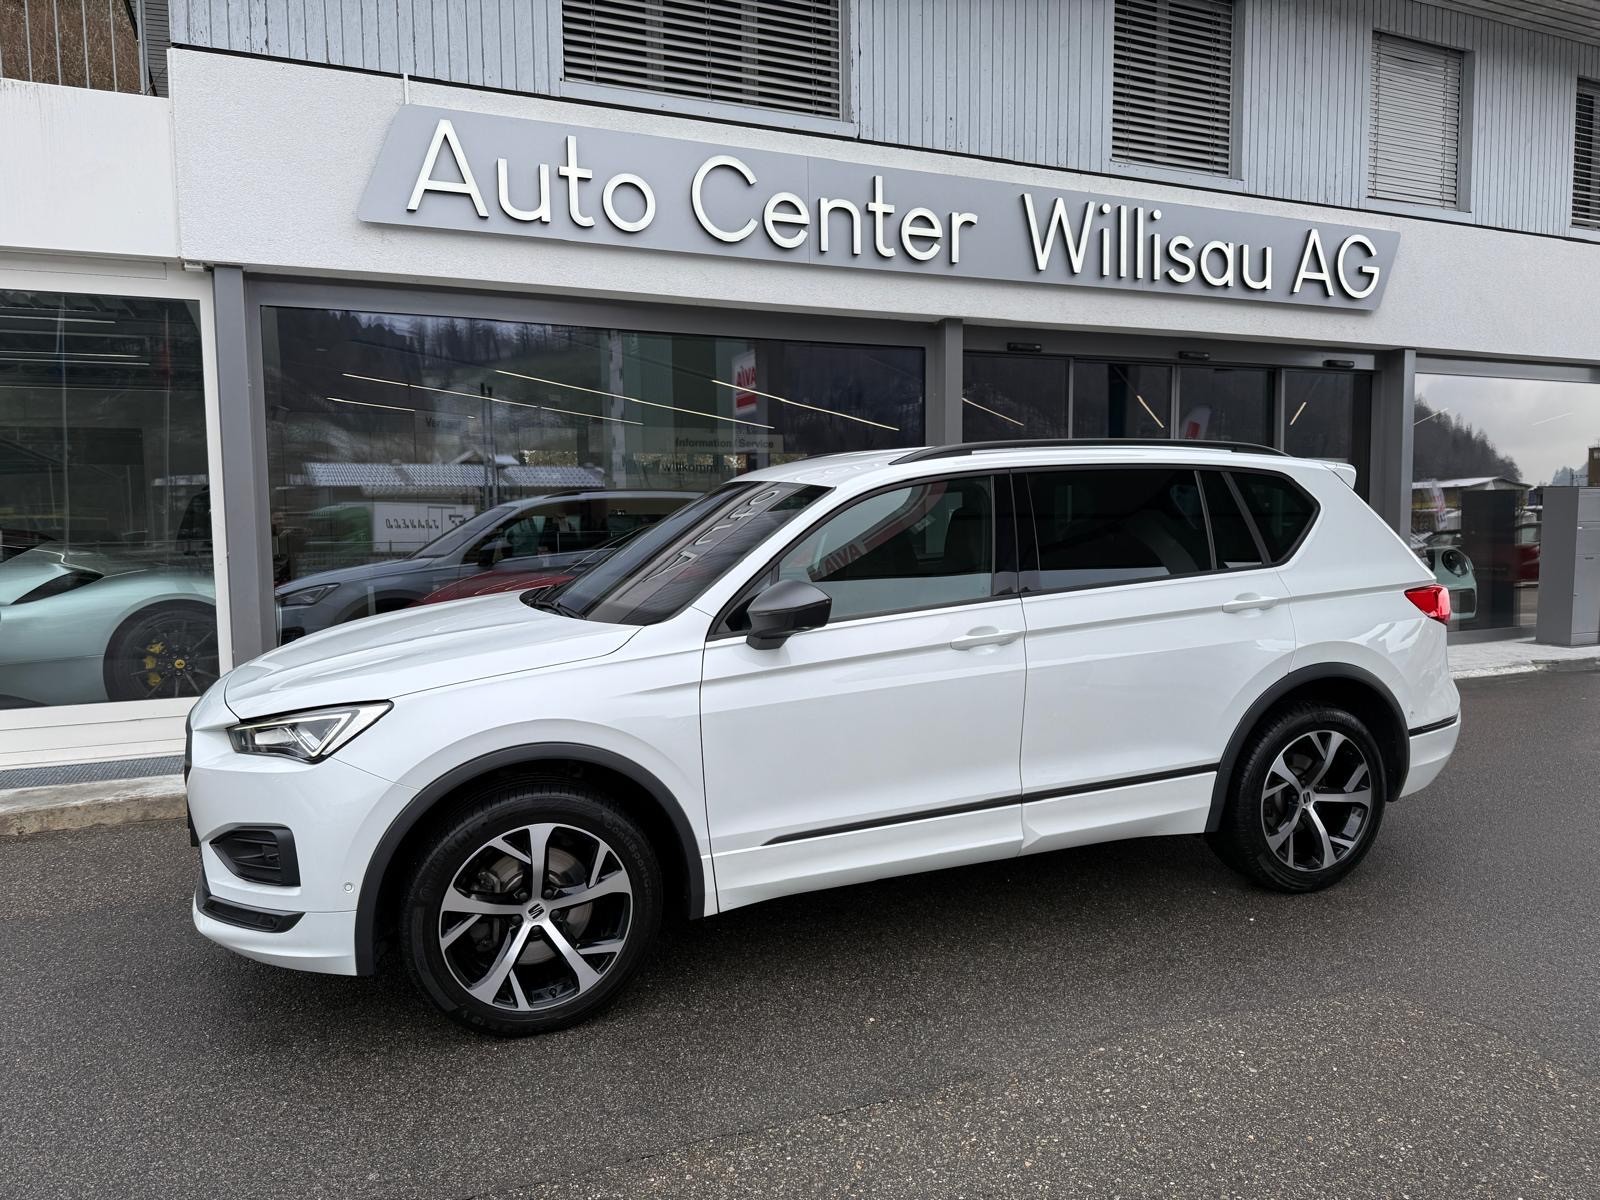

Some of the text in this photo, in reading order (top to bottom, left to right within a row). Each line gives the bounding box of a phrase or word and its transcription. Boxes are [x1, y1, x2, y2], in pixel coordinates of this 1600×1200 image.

[406, 119, 1380, 300] Auto Center Willisau AG
[675, 437, 732, 448] Information
[738, 438, 774, 449] Service
